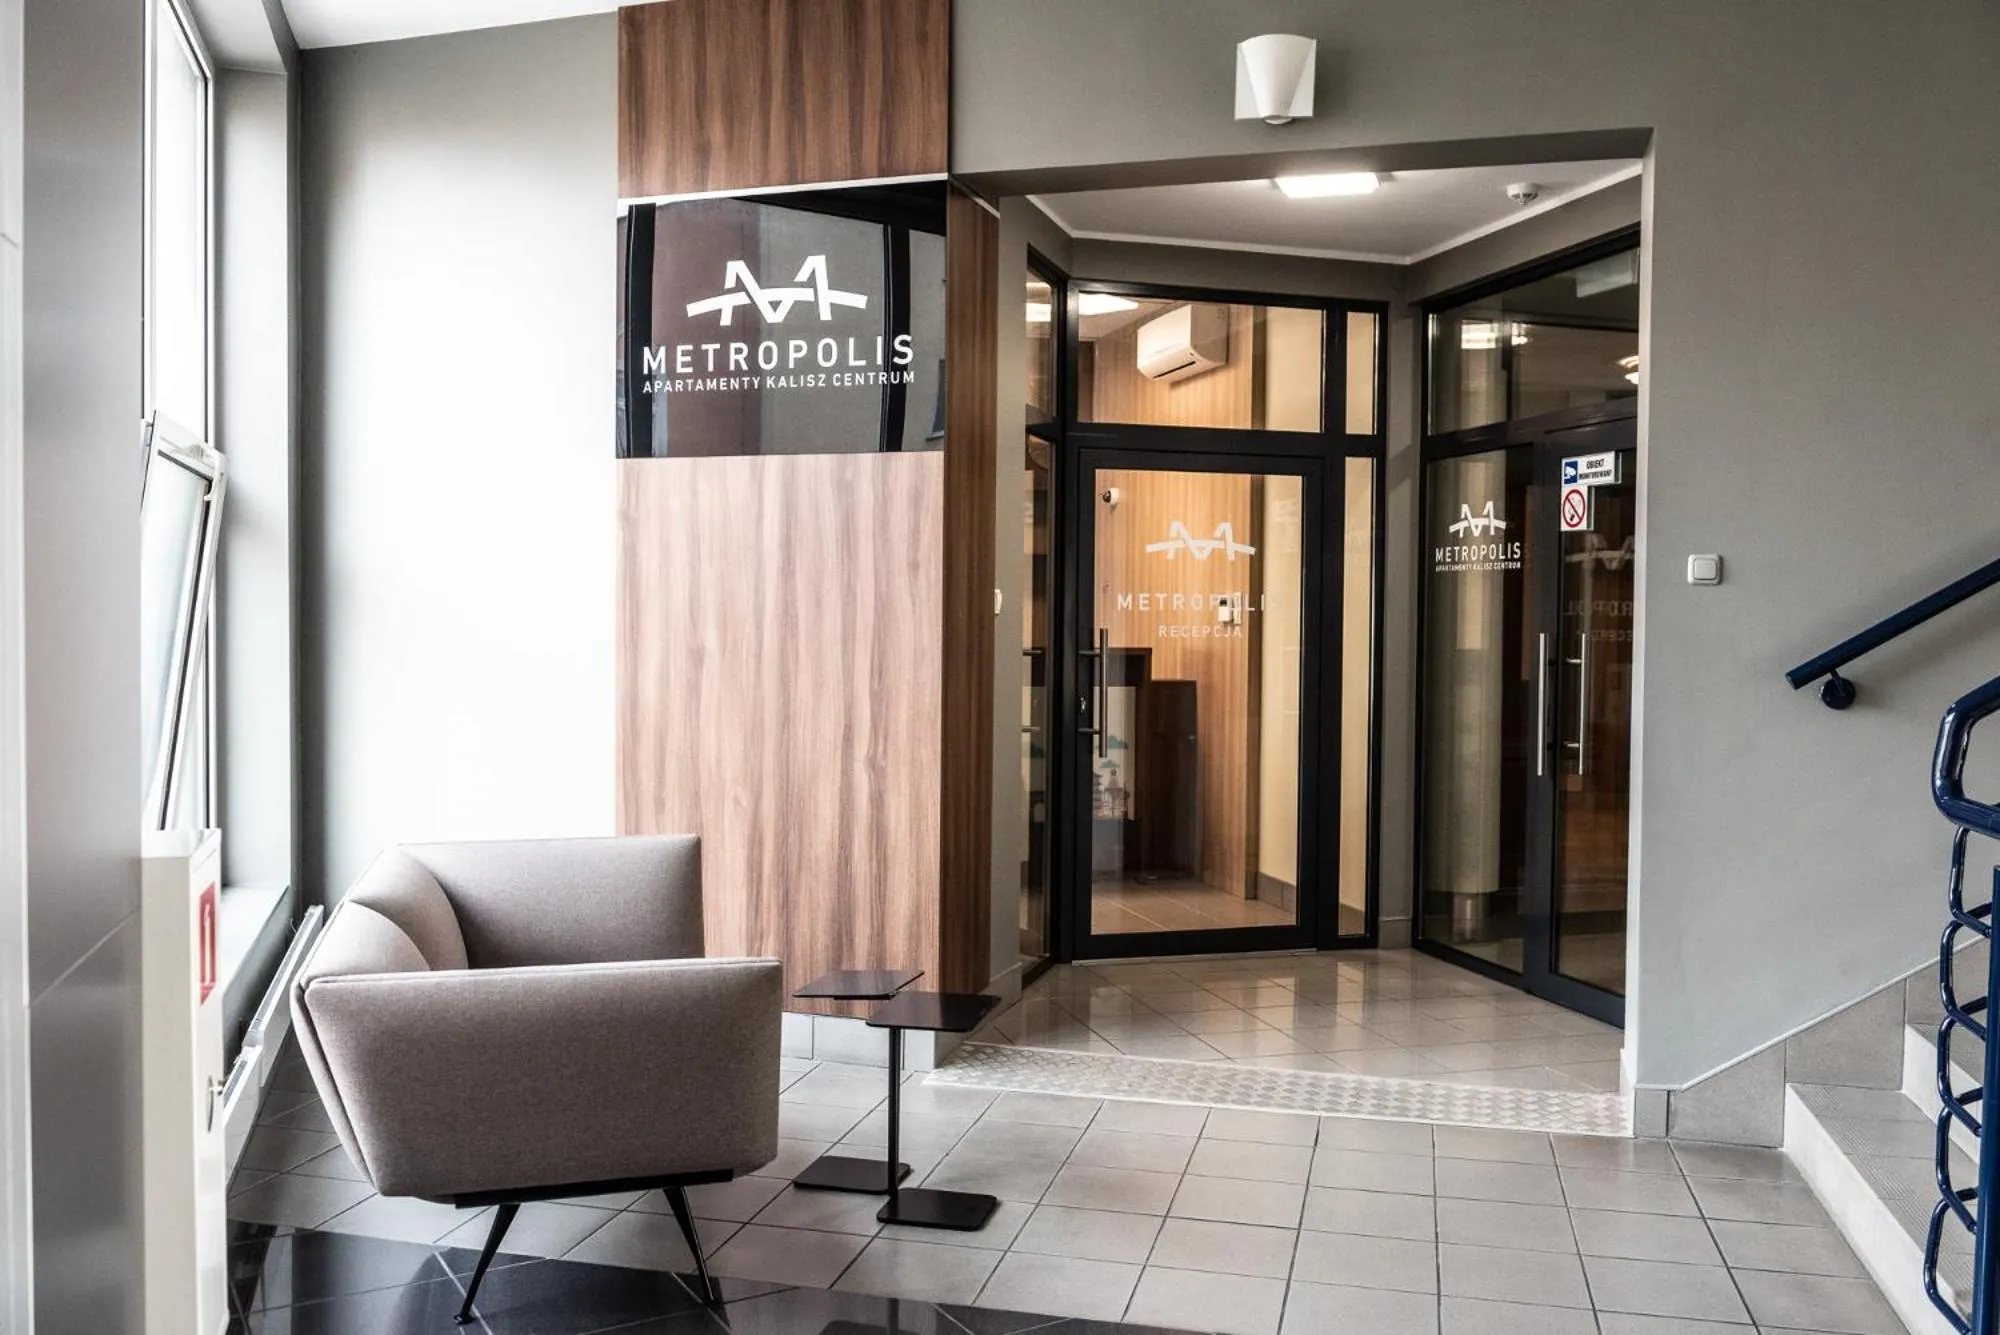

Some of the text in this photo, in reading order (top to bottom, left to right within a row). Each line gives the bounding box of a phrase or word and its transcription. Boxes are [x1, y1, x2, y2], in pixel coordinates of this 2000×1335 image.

[642, 334, 914, 375] METROPOLIS
[642, 371, 915, 393] APARTAMENTY KALISZ CENTRUM
[1435, 542, 1521, 563] METROPOLIS
[1117, 592, 1266, 611] METROPLI
[1158, 624, 1243, 638] RECEPCJA
